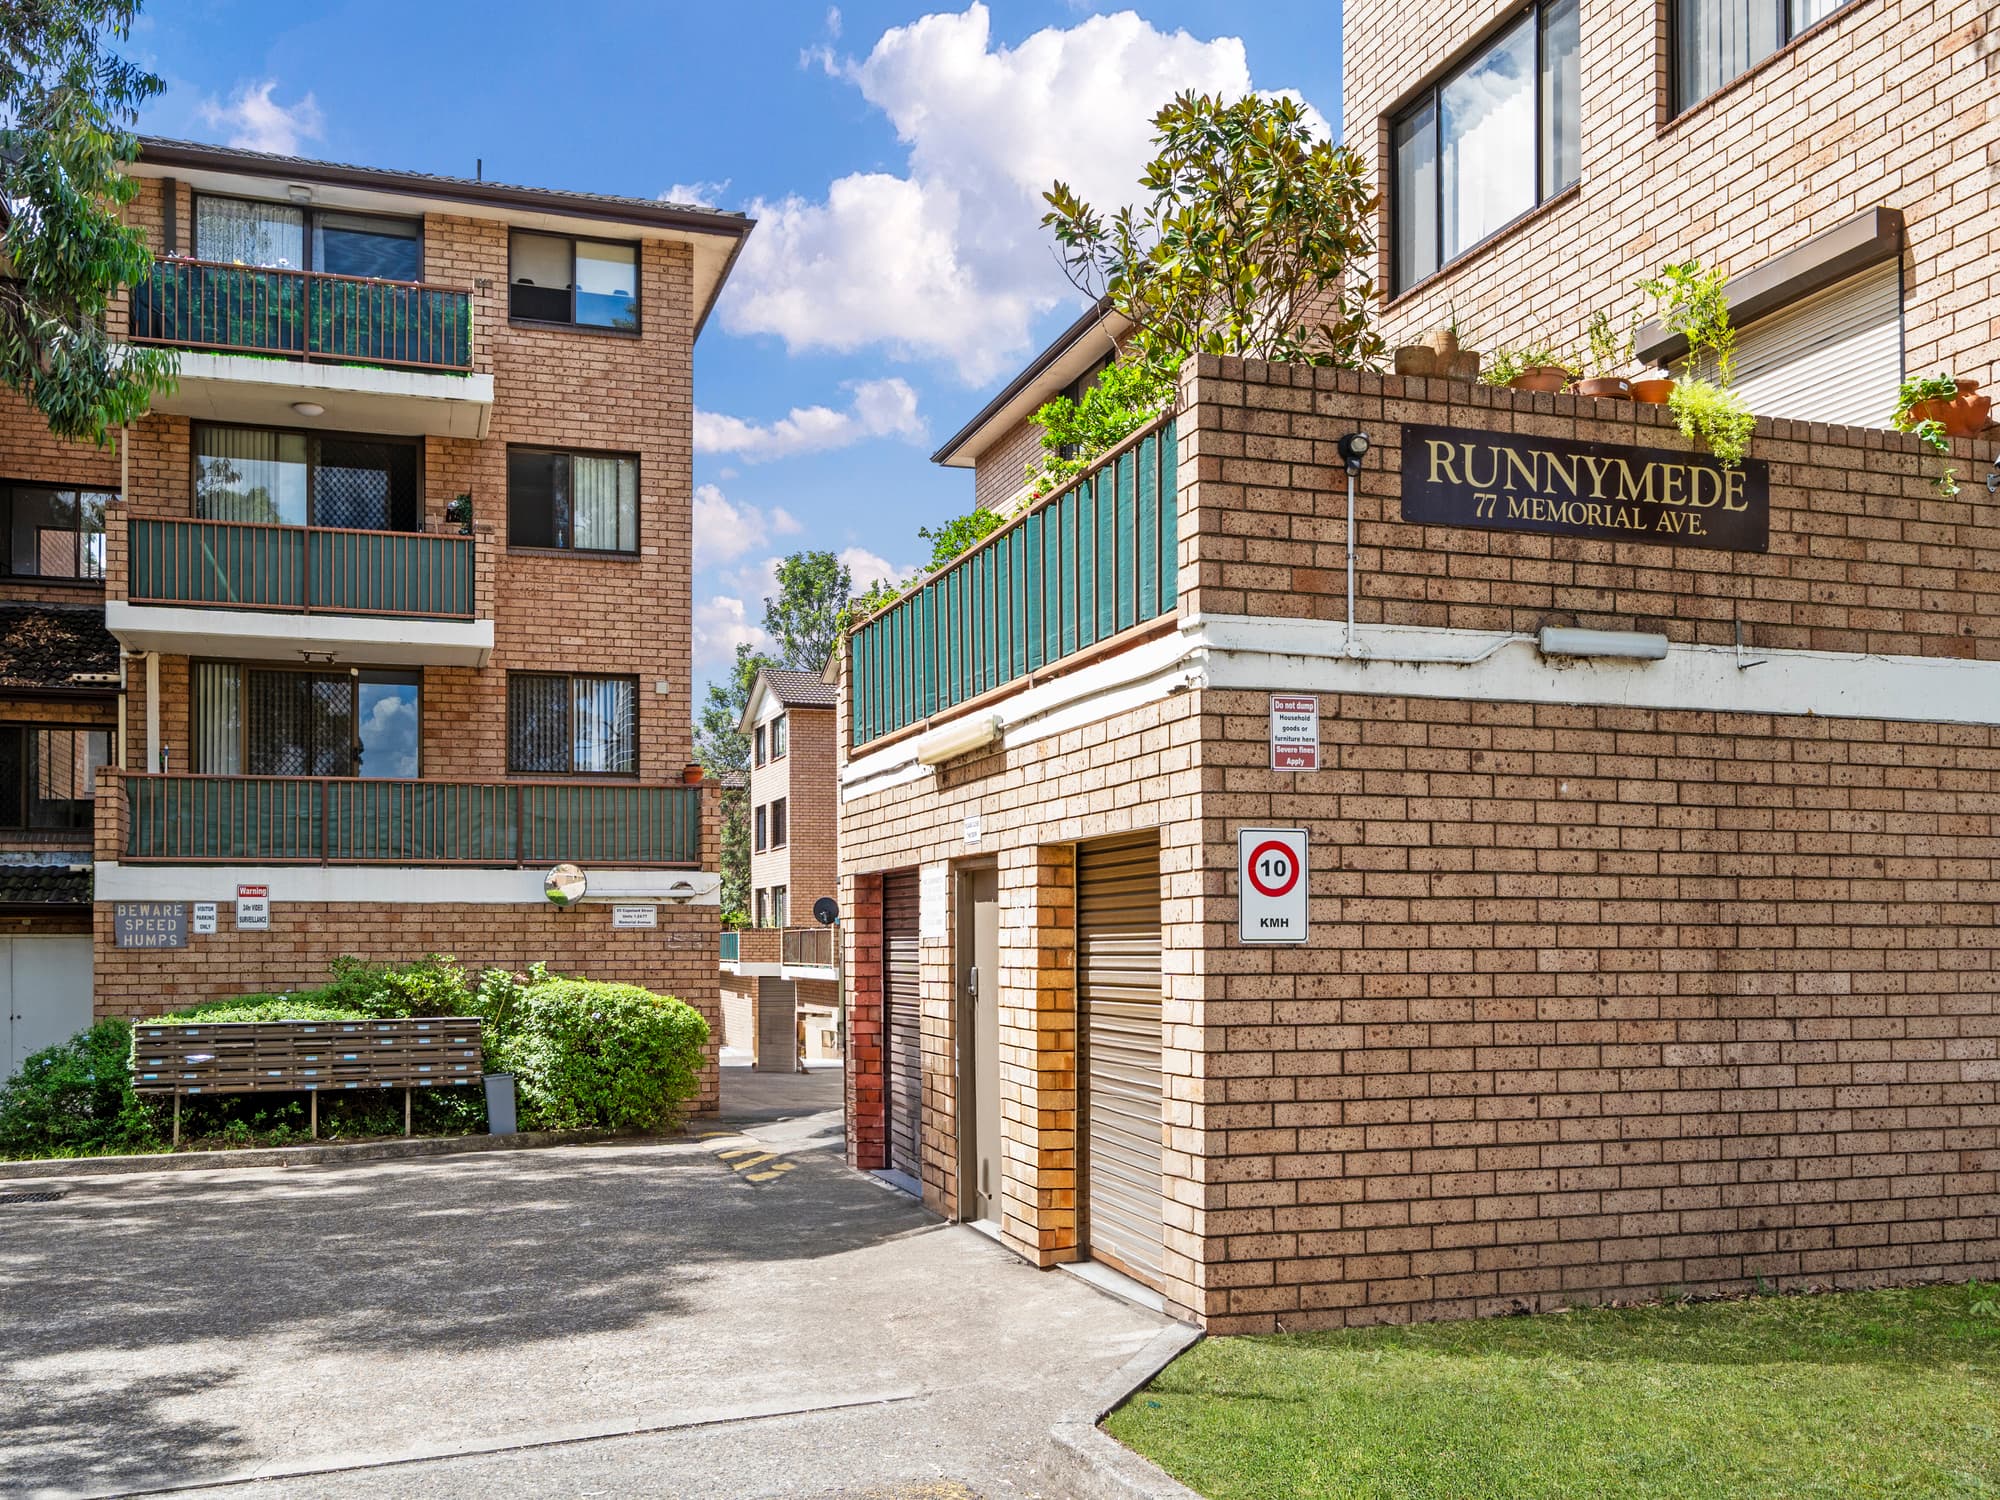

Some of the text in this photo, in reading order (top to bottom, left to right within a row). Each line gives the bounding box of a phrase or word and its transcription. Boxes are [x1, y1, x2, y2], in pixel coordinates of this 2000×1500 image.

[1425, 440, 1749, 512] RUNNYMEDE
[1473, 492, 1707, 536] 77 MEMORIAL AVE.
[1275, 701, 1314, 712] Do not dump
[1287, 758, 1304, 766] Apply
[1261, 860, 1286, 877] 10
[239, 887, 267, 896] Warning
[117, 905, 183, 916] BEWARE
[125, 919, 176, 931] SPEED
[1260, 918, 1289, 928] KMH
[124, 934, 177, 946] HUMPS
